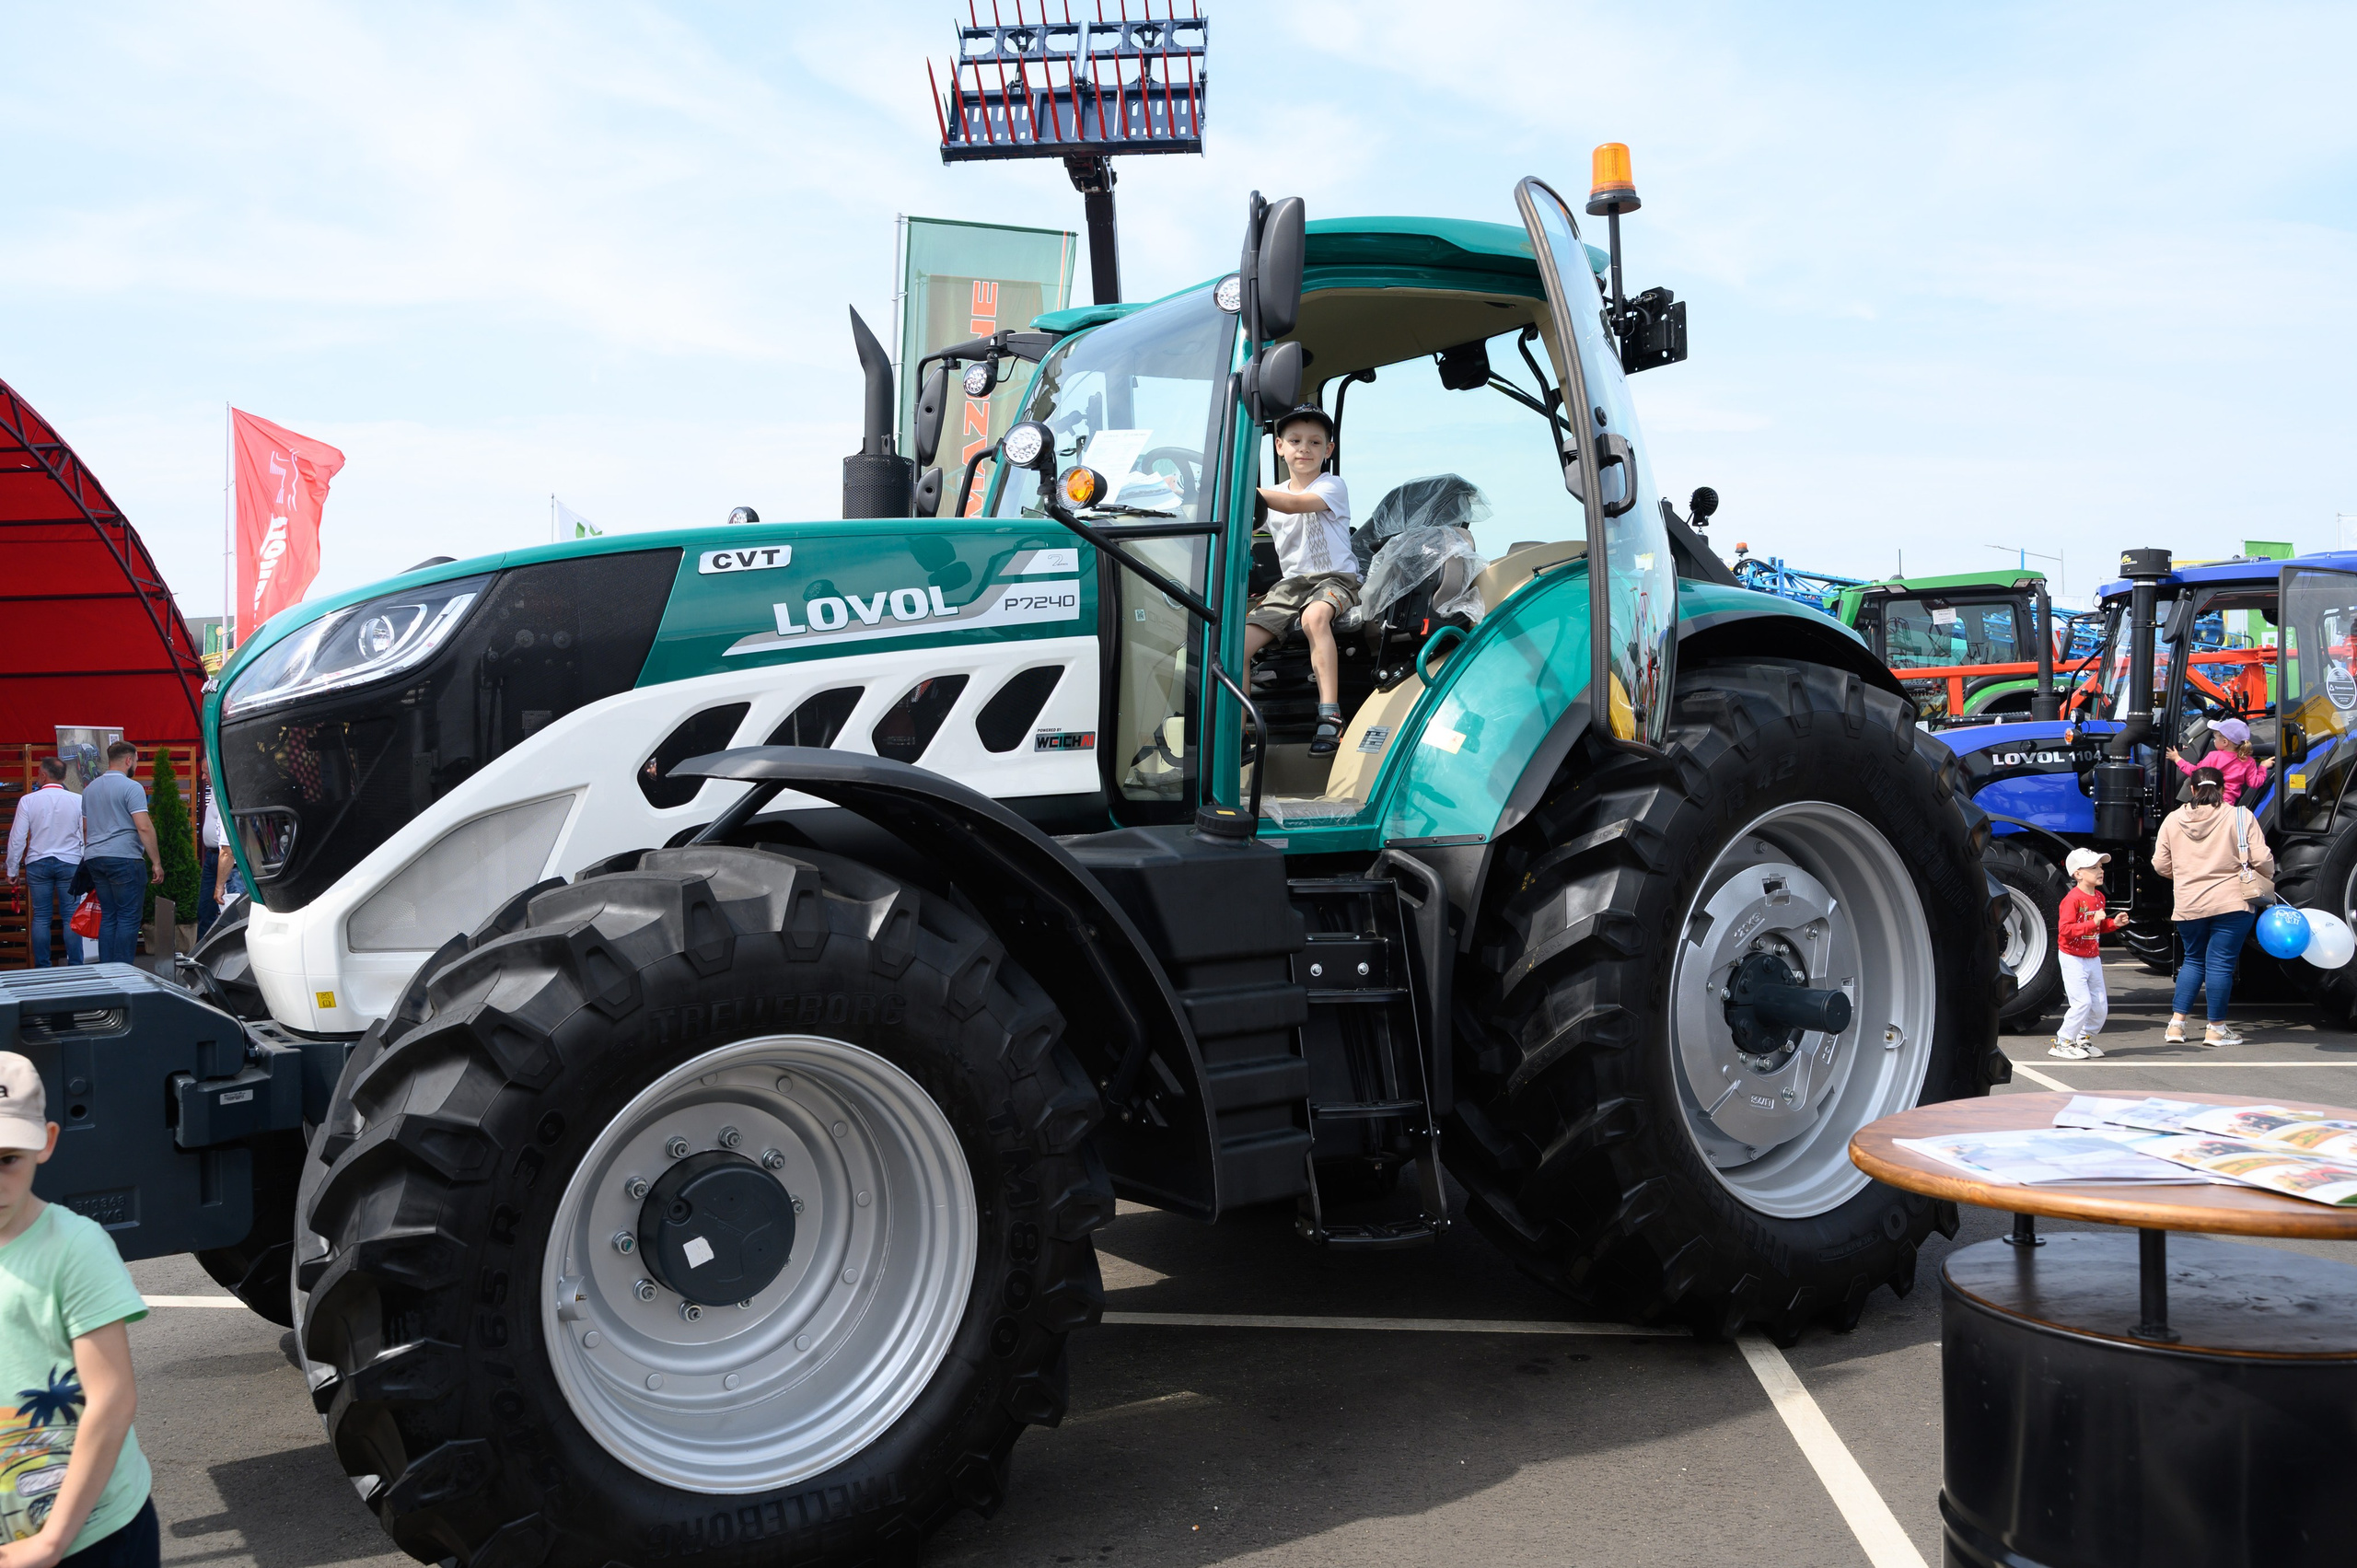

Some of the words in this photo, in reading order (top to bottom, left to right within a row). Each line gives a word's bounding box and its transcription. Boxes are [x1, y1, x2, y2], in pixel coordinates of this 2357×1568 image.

[960, 280, 999, 518] MAZNE
[712, 549, 781, 570] CVT
[772, 585, 959, 636] LOVOL
[1004, 594, 1075, 611] P7240
[1037, 734, 1095, 749] WEICHAI
[1991, 751, 2066, 766] LOVOL
[2068, 749, 2103, 762] 1104
[650, 992, 908, 1043] TRELLEBORG
[487, 1202, 524, 1249] R
[512, 1109, 567, 1190] 30
[85, 1208, 124, 1224] 0KG
[645, 1471, 907, 1562] TRELLEBORG
